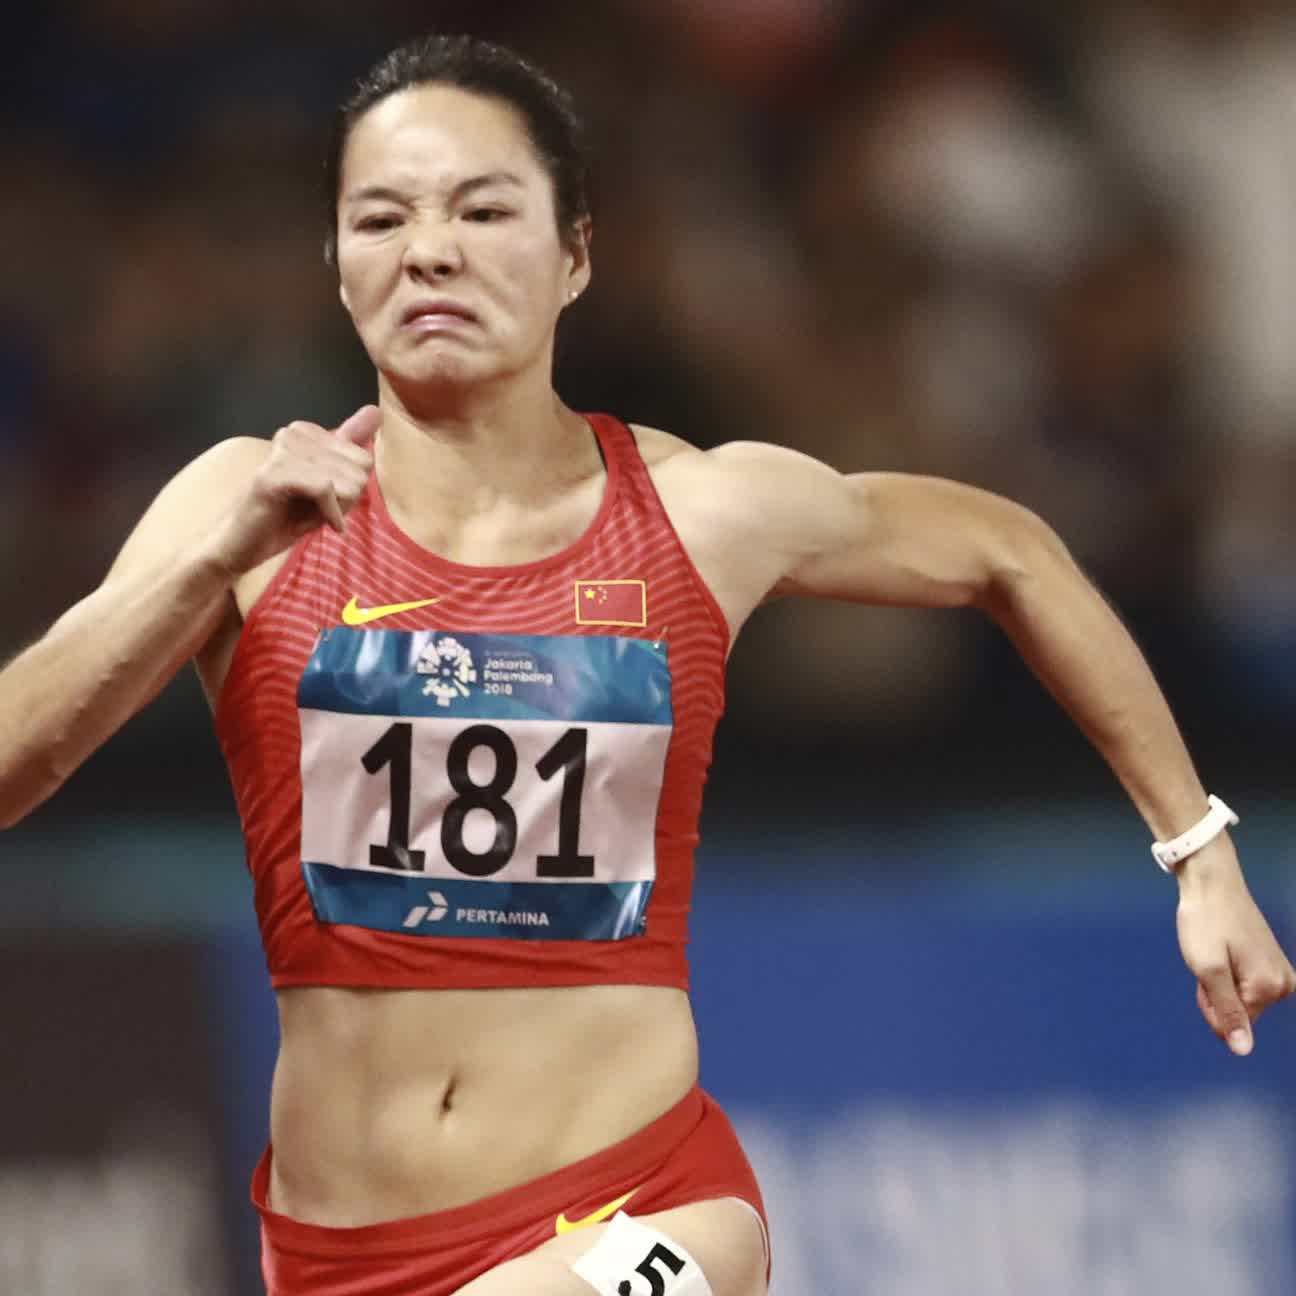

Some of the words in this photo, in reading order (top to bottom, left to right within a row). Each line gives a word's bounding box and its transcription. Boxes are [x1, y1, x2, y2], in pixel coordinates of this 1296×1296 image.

[483, 670, 553, 686] Palembang
[360, 722, 595, 877] 181
[456, 908, 550, 926] PERTAMINA
